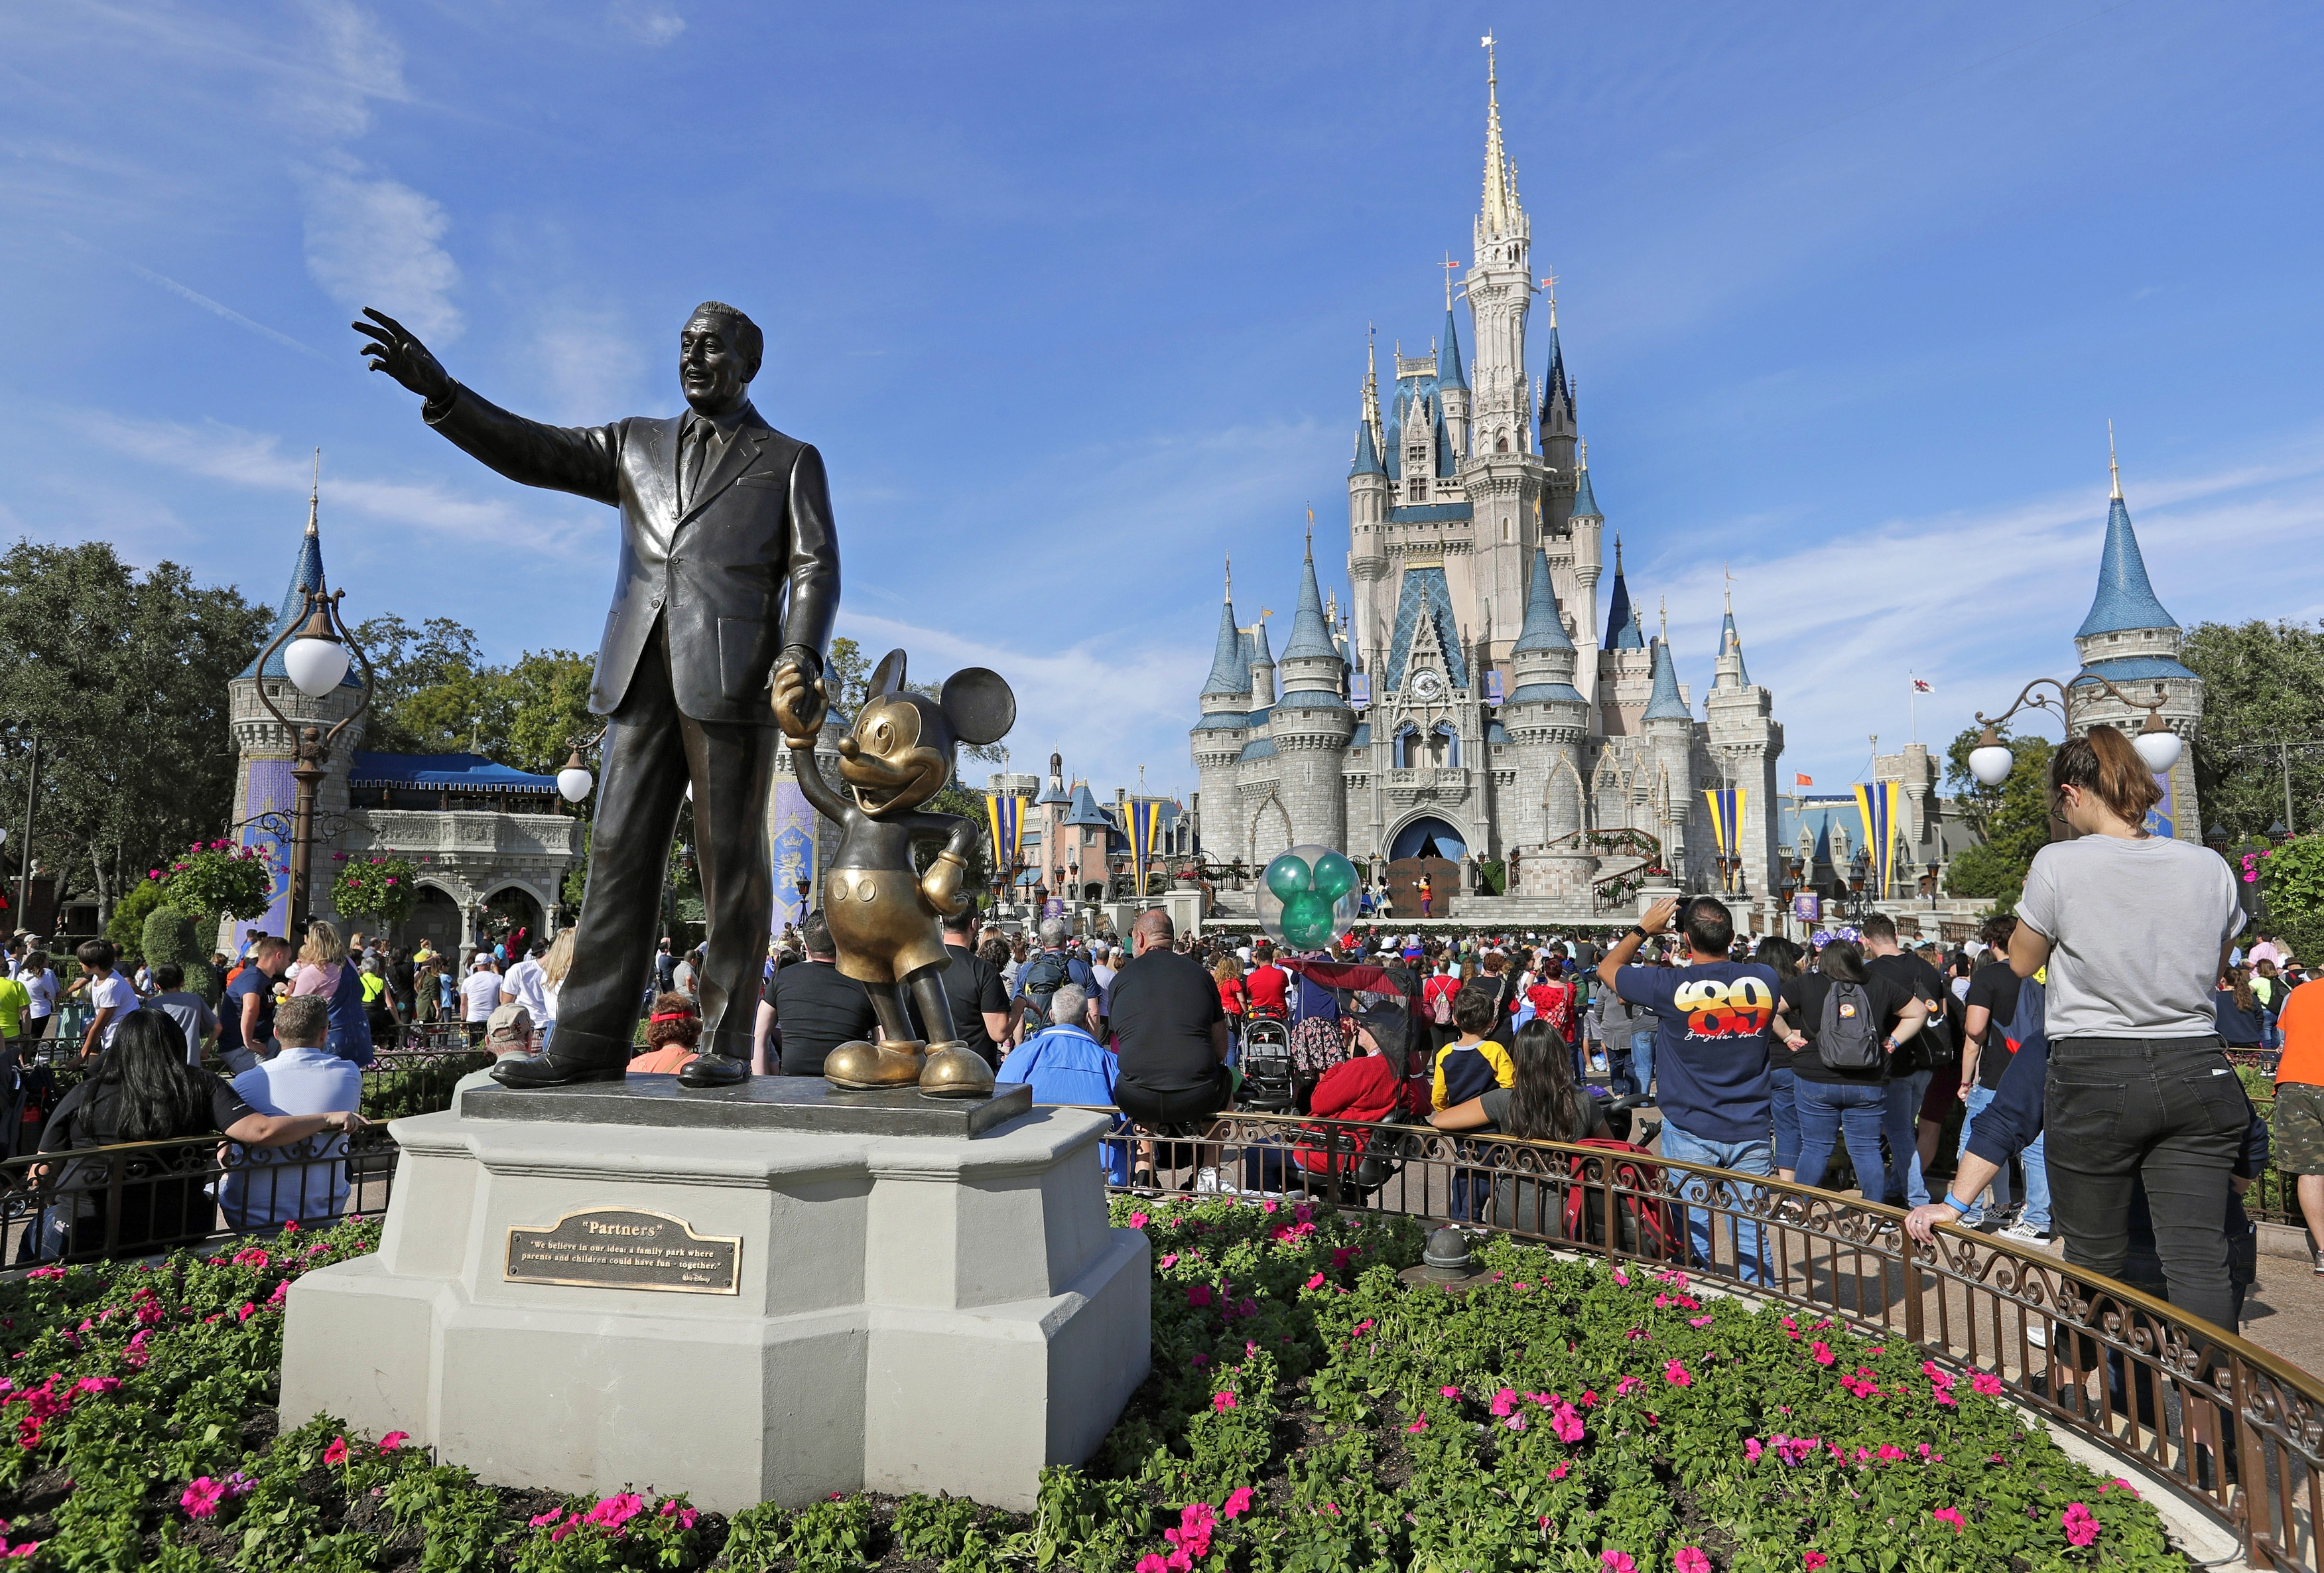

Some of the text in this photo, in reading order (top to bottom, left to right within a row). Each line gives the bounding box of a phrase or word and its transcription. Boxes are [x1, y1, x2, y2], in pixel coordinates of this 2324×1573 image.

[1684, 1028, 1733, 1042] Brazilian
[547, 1241, 577, 1251] believe
[636, 1247, 663, 1257] family
[665, 1249, 686, 1257] park
[687, 1249, 714, 1258] where
[572, 1255, 608, 1264] children
[635, 1258, 654, 1266] have
